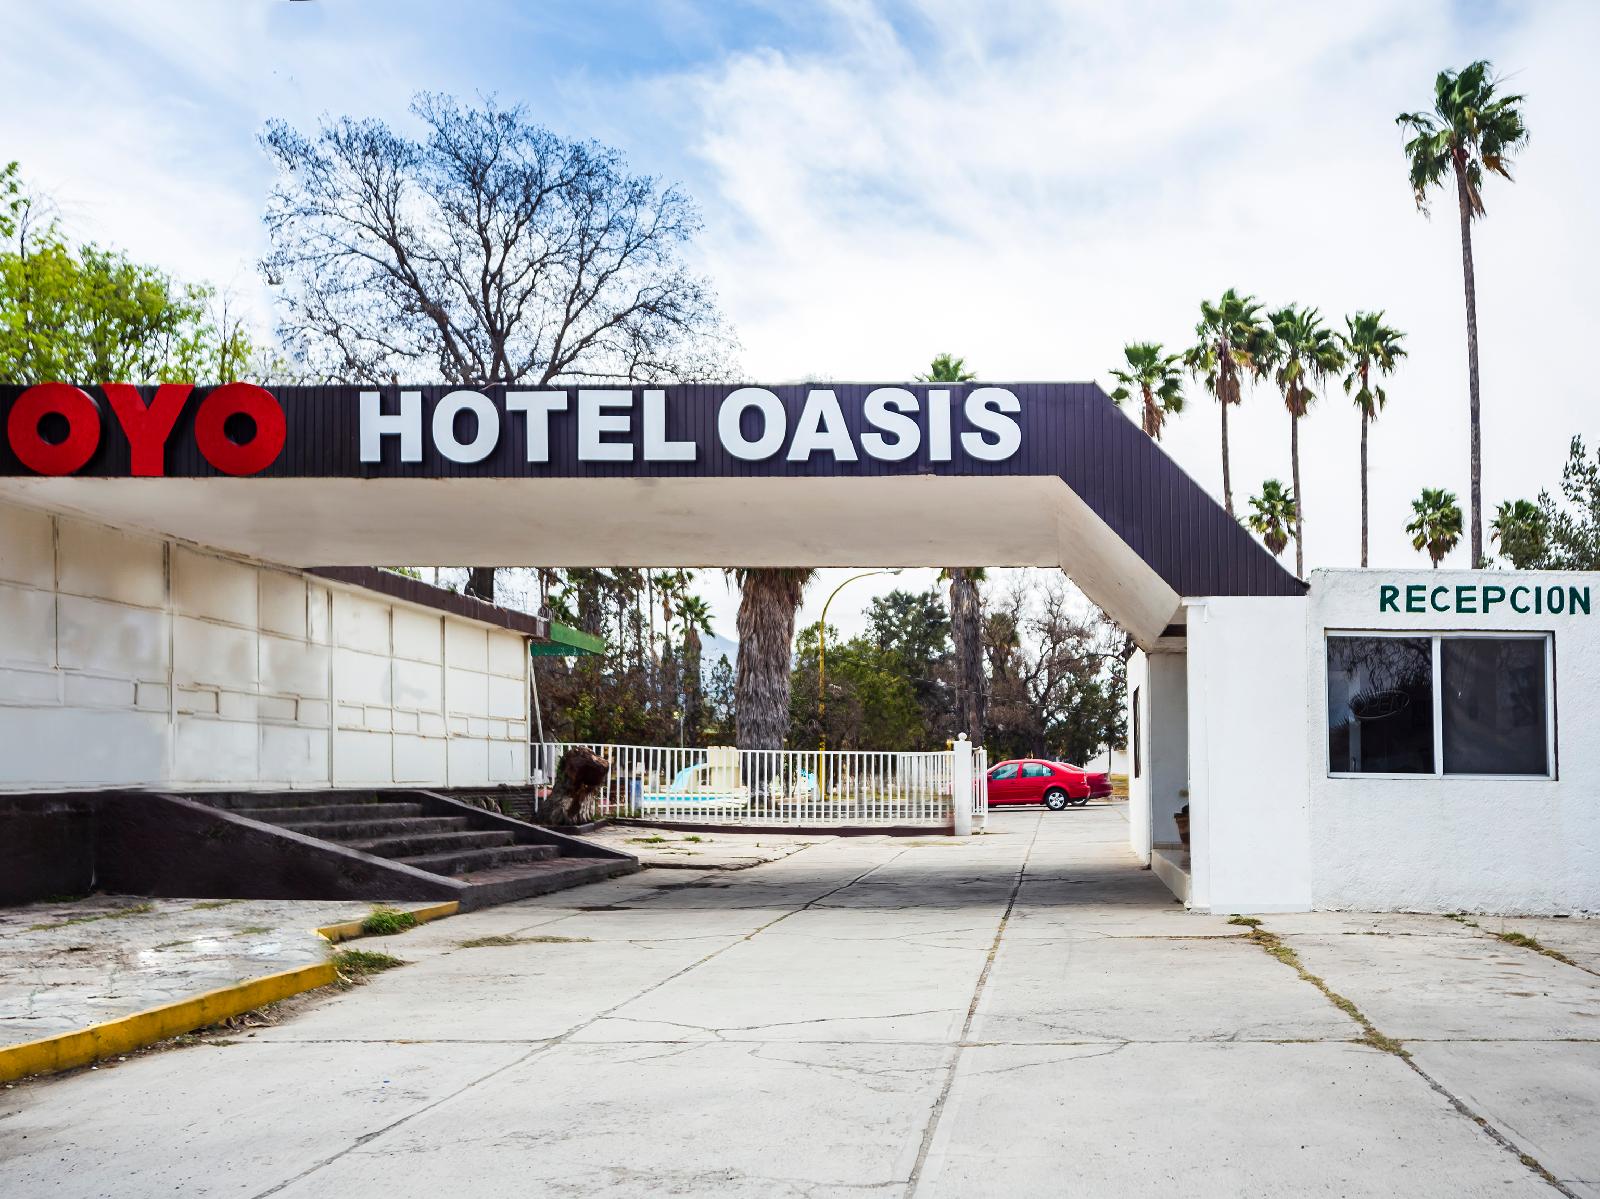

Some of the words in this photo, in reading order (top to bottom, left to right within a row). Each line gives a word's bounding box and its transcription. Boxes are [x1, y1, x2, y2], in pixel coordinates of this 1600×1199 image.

[8, 383, 286, 476] OYO
[359, 390, 696, 463] HOTEL
[718, 387, 1021, 461] OASIS
[1379, 585, 1591, 614] RECEPCION
